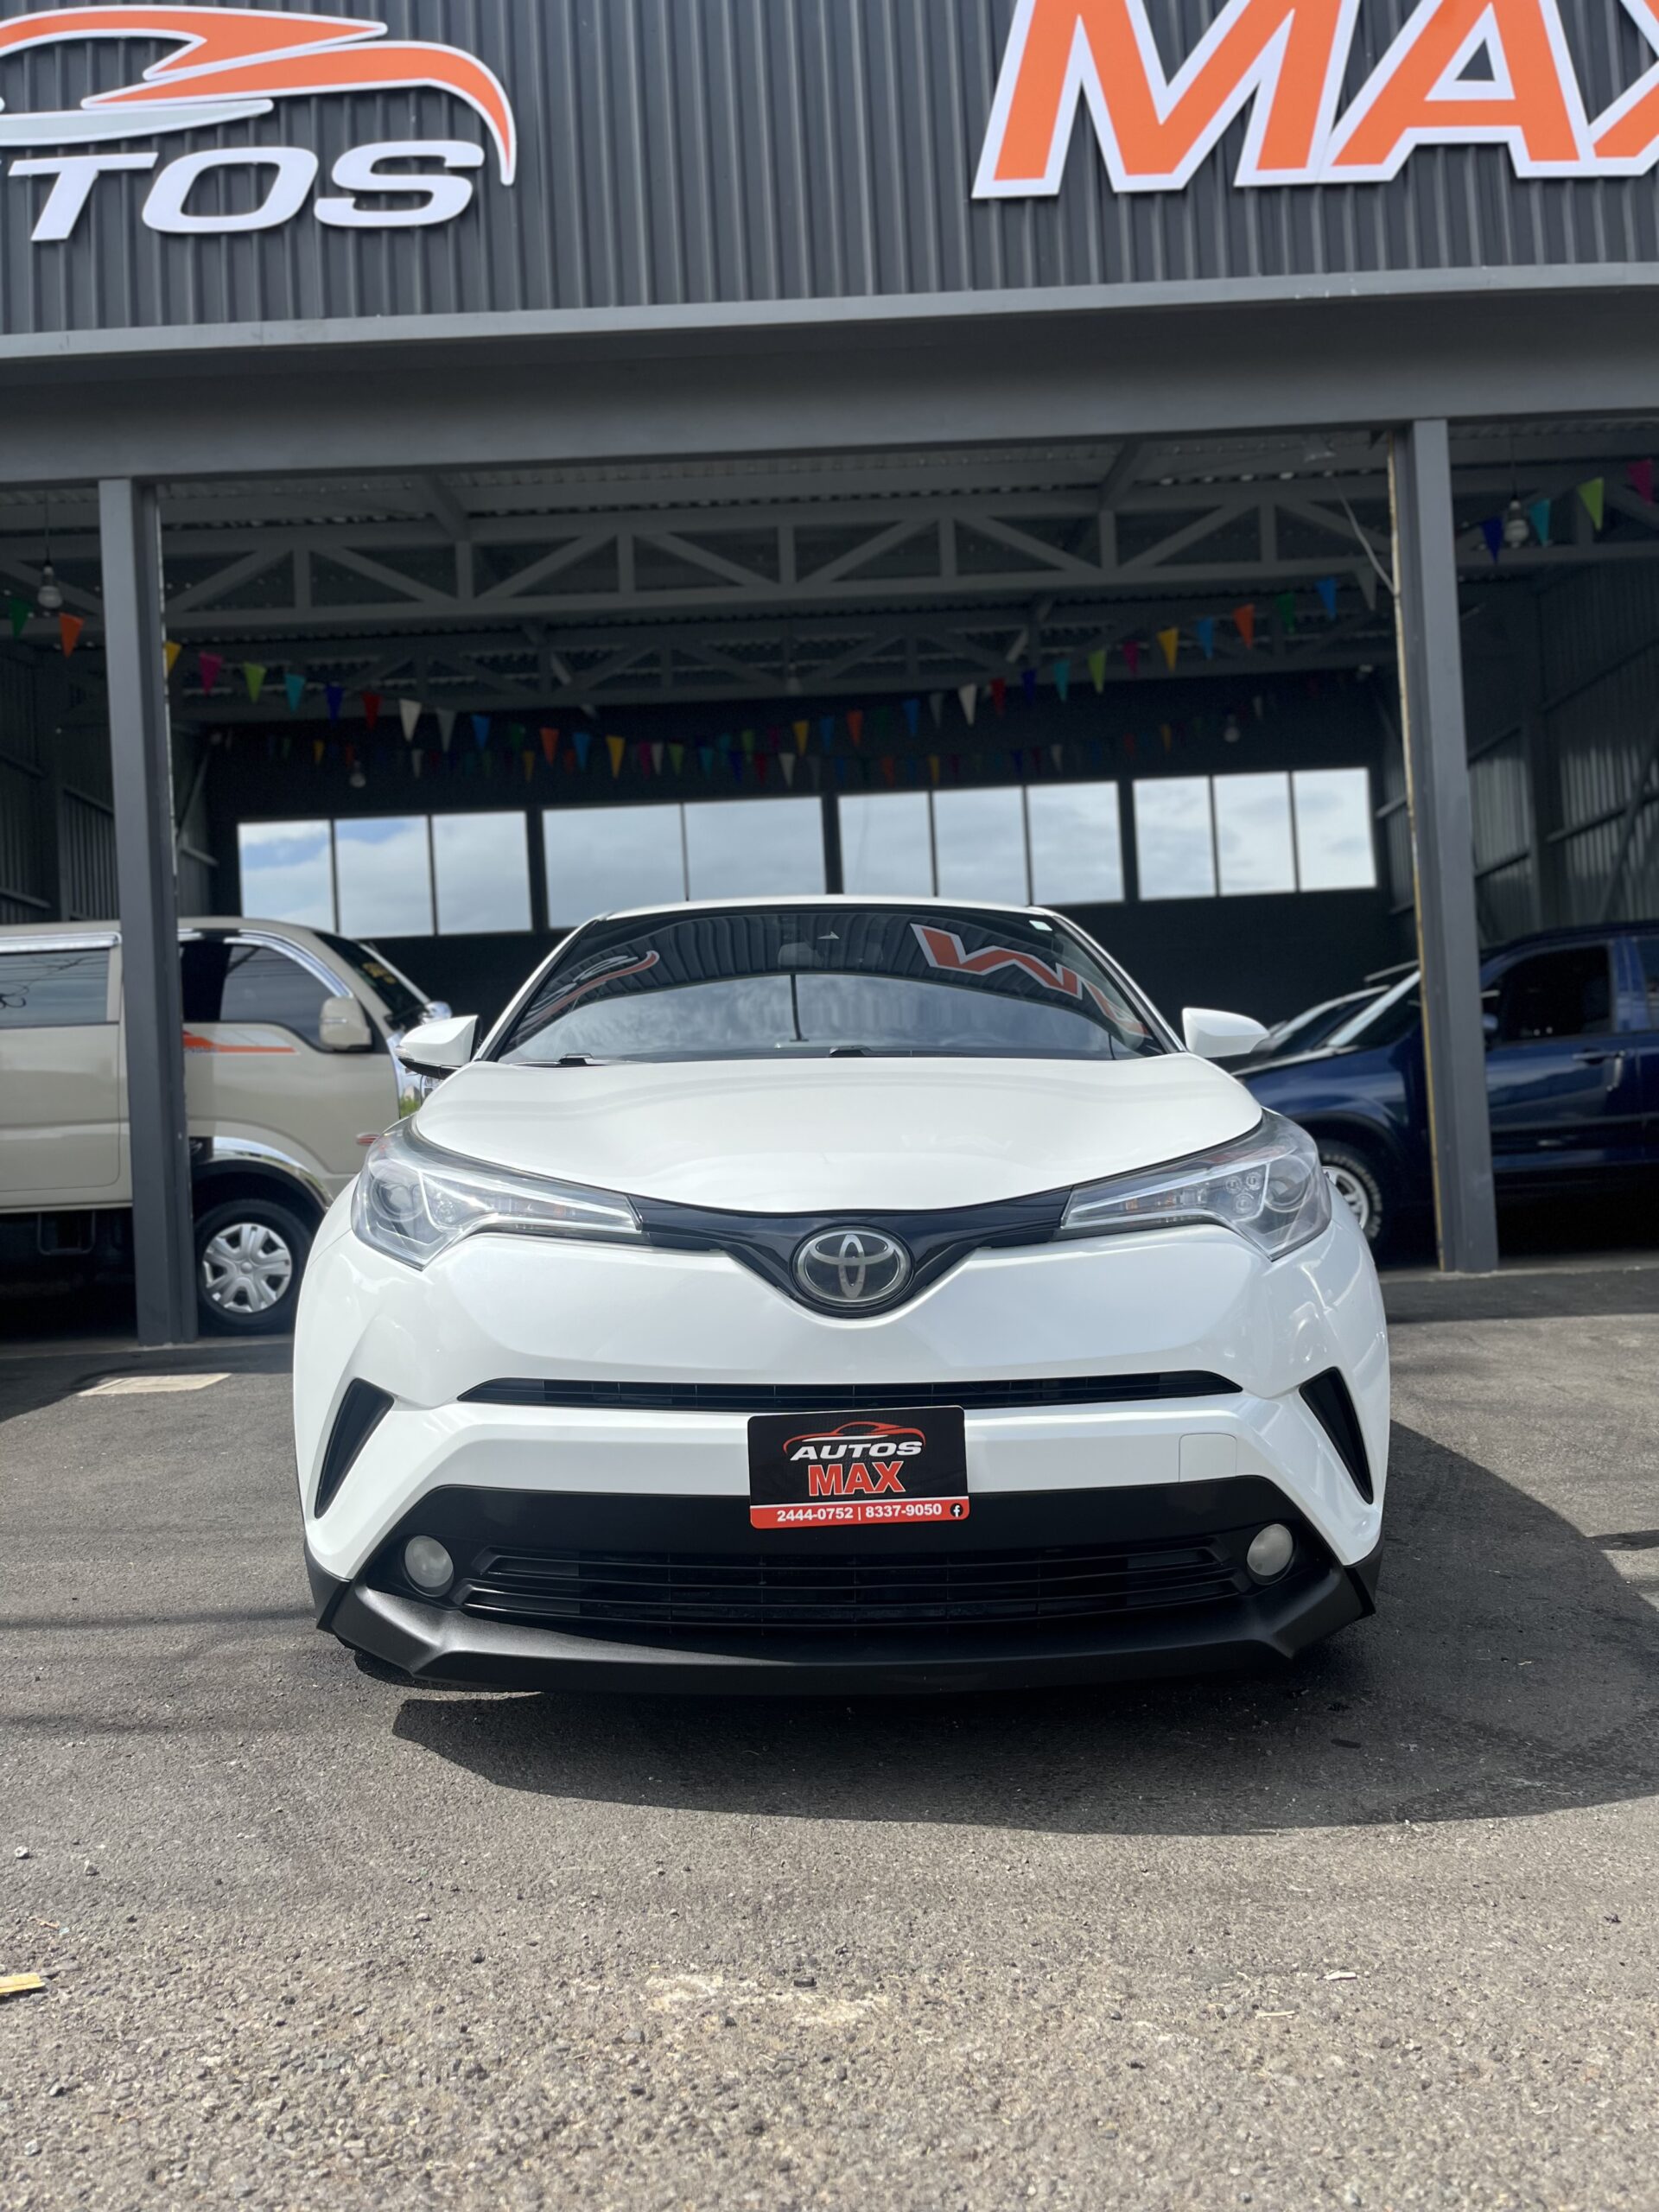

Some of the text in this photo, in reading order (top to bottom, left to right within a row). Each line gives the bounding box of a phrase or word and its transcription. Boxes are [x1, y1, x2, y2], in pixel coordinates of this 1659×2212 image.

[790, 1440, 923, 1461] AUTOS
[808, 1460, 906, 1497] MAX
[777, 1507, 854, 1522] 2444-0752
[865, 1503, 943, 1518] 8337-9050
